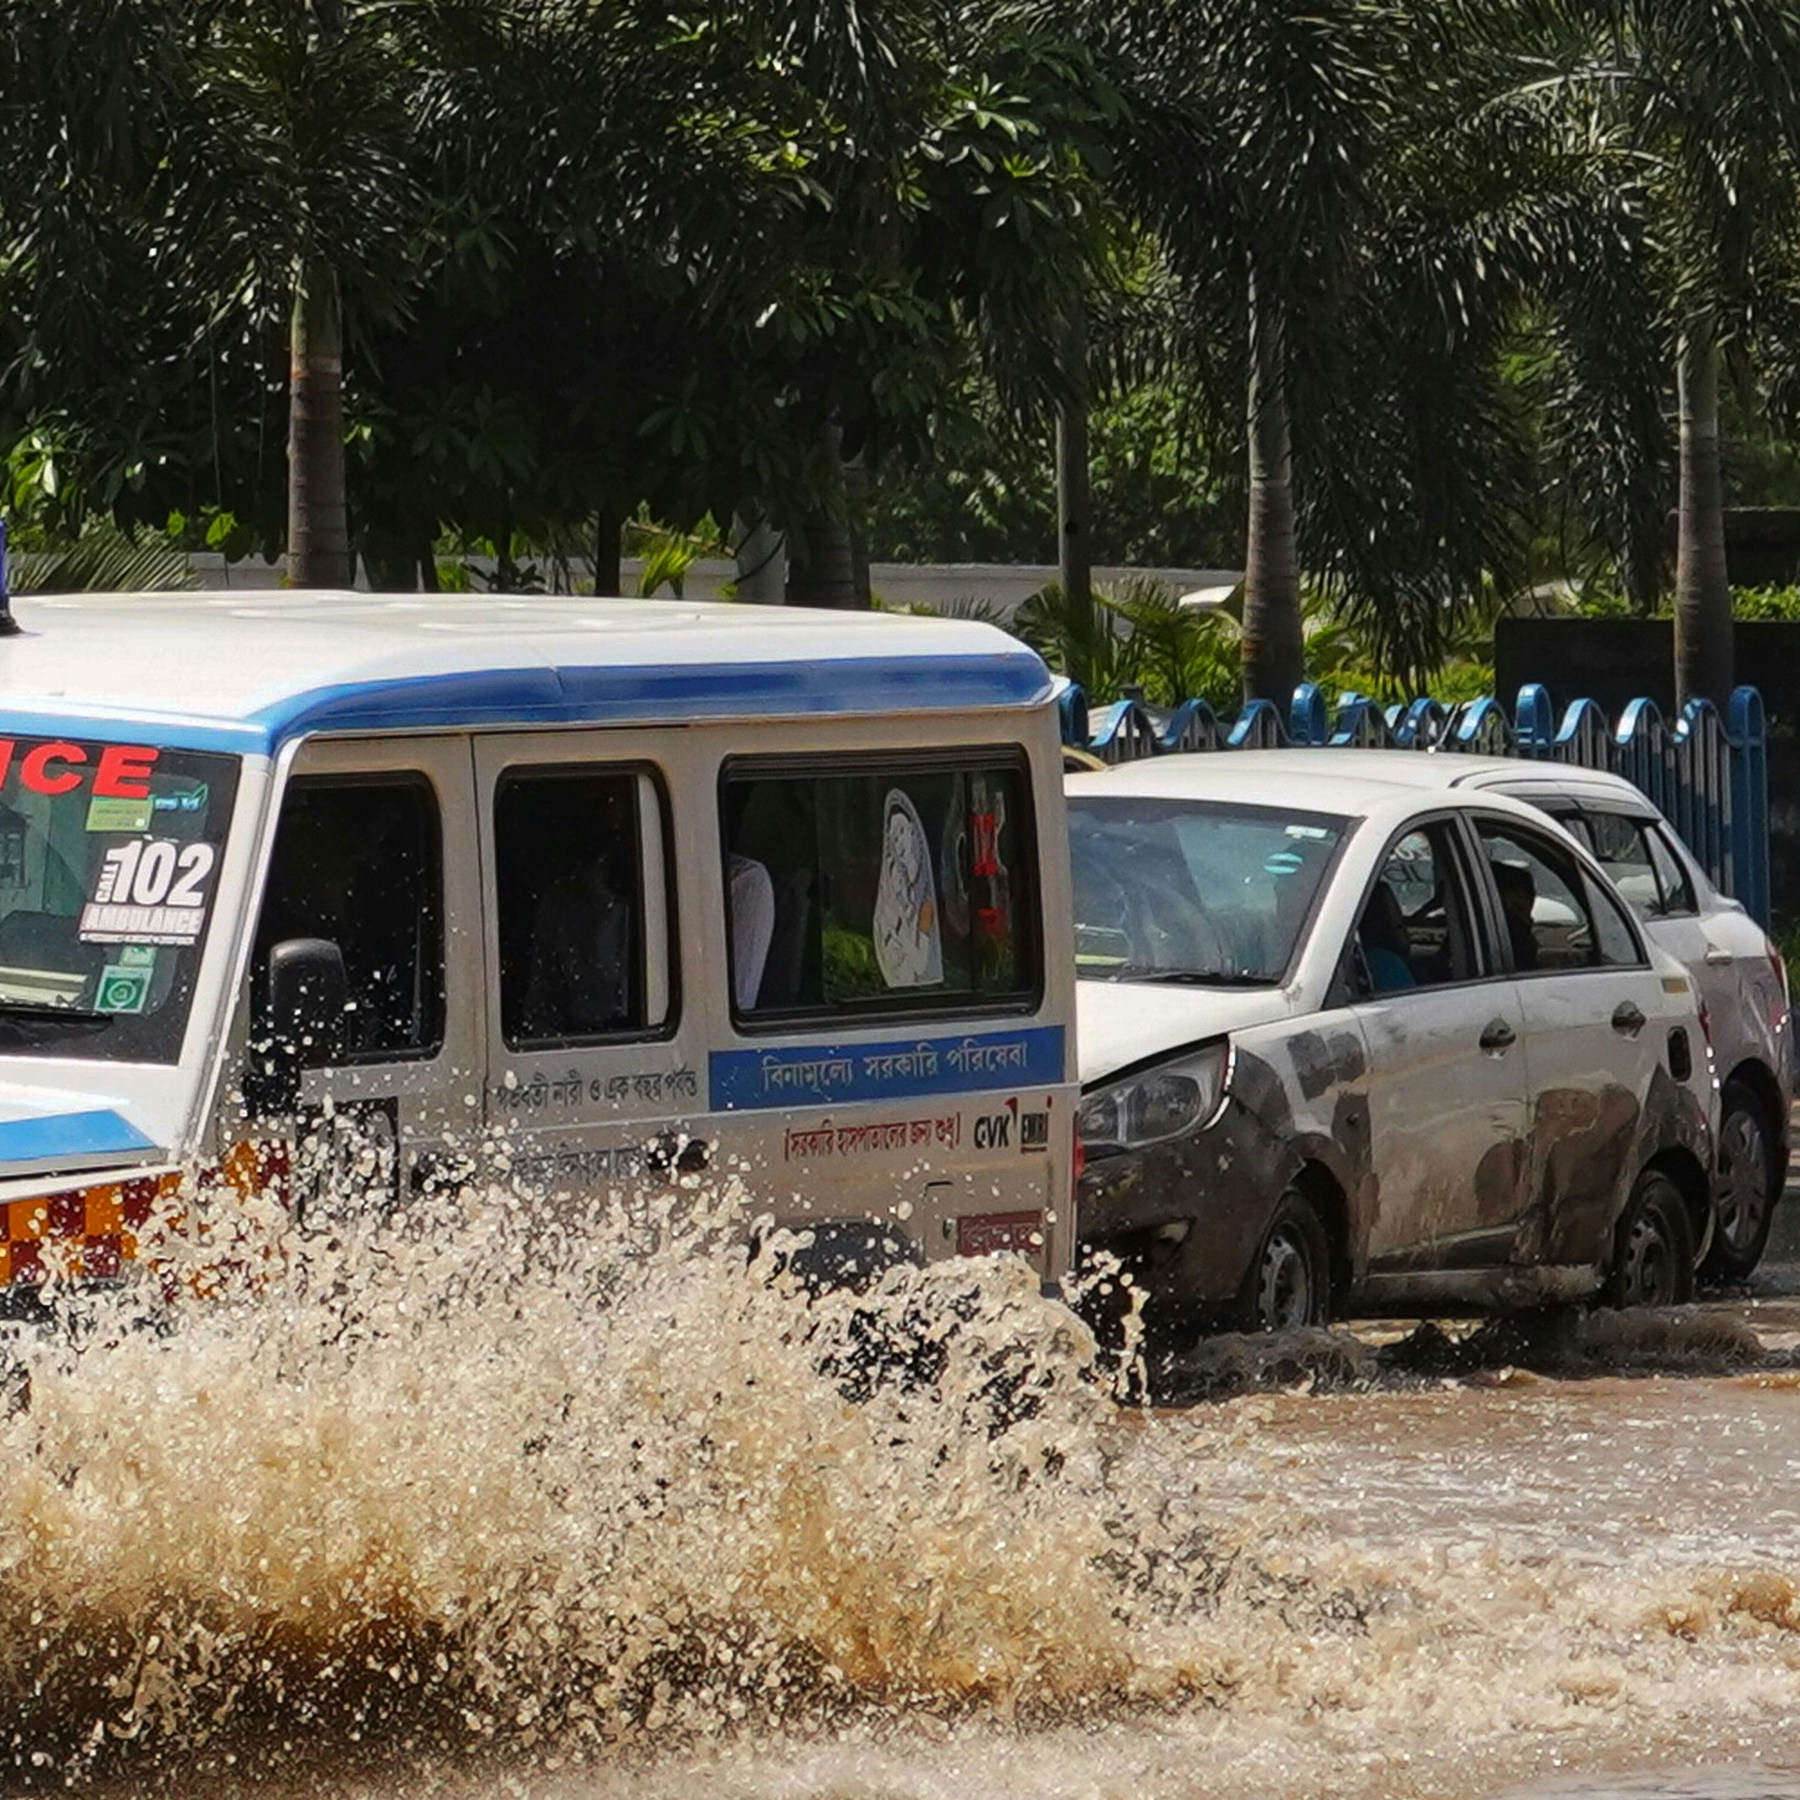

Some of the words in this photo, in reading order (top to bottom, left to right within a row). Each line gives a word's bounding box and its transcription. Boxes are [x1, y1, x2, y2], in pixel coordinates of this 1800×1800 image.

[107, 840, 214, 906] 102
[863, 1042, 938, 1080] সরকারি
[946, 1038, 1028, 1073] পরিষেবা
